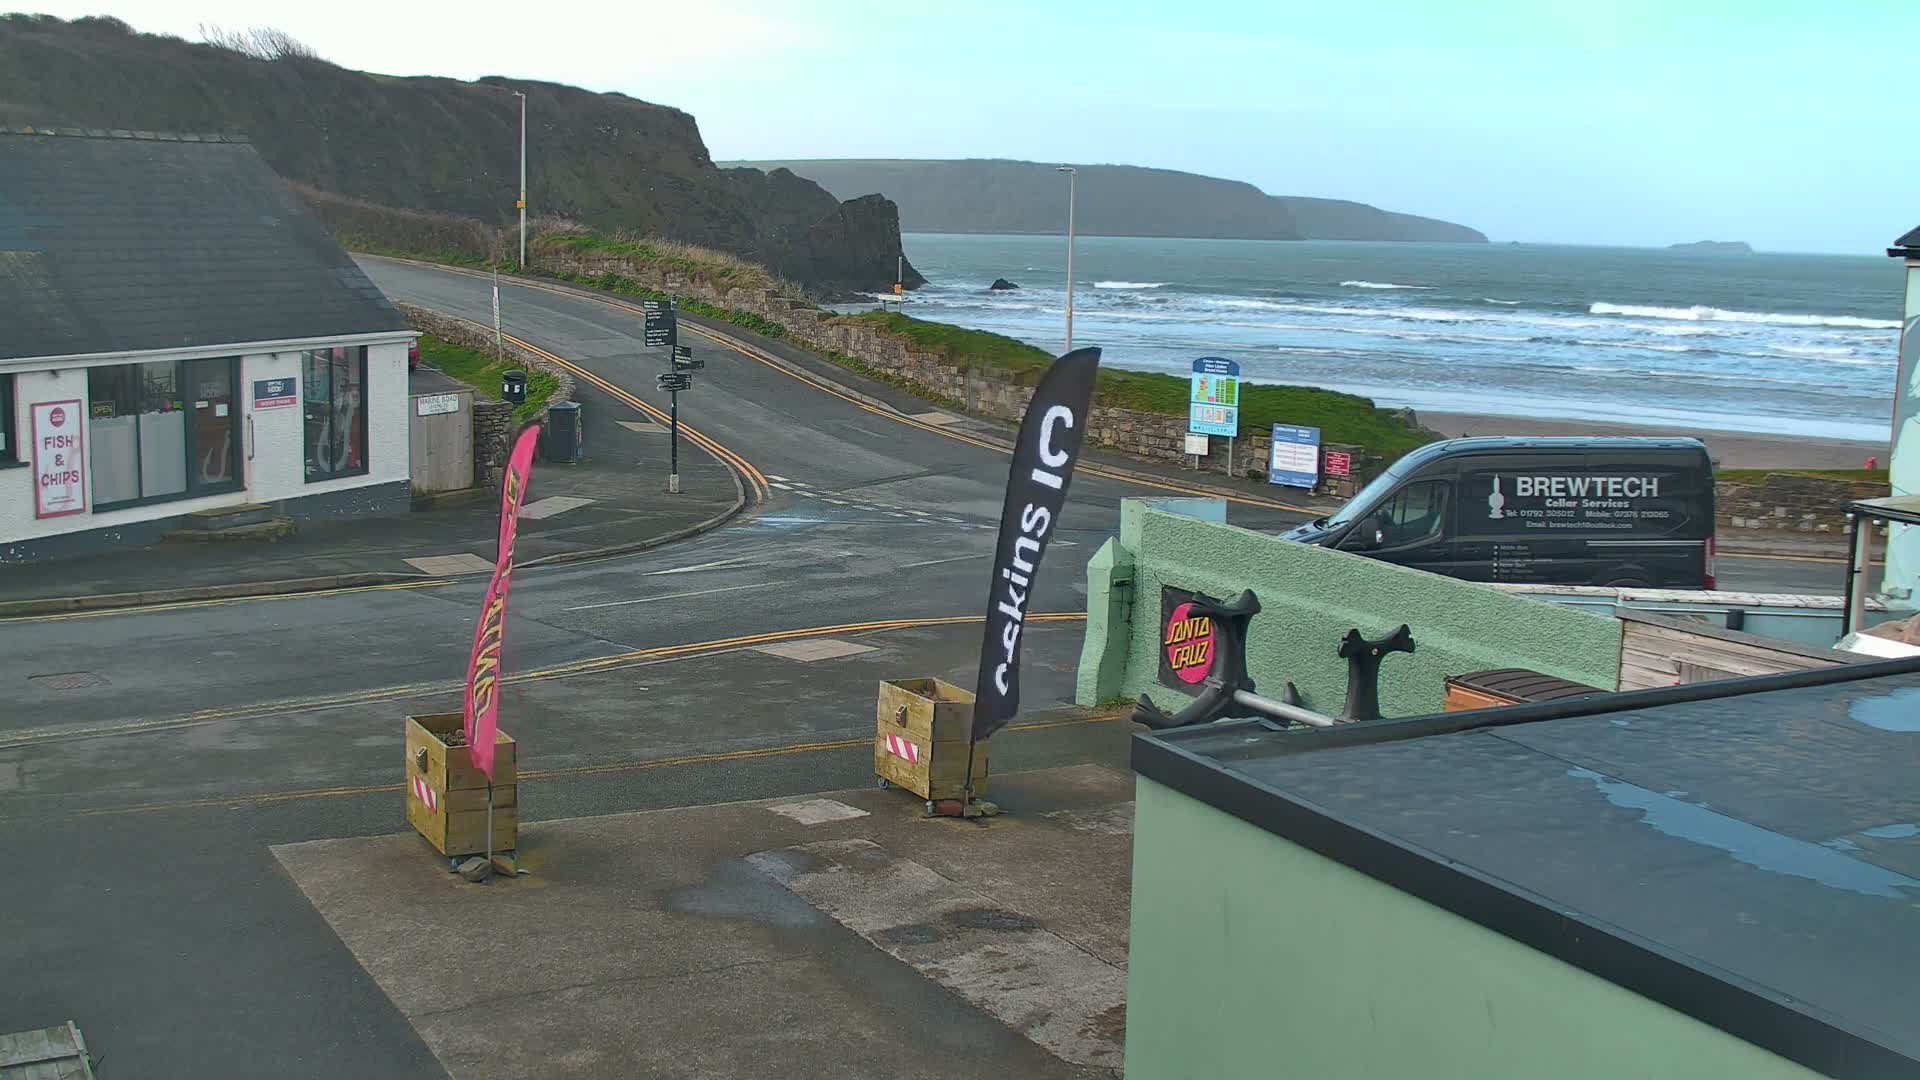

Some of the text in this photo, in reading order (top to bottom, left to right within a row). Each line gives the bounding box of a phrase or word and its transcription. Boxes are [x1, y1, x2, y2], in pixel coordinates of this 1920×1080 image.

[44, 435, 73, 450] FISH
[54, 454, 65, 466] &
[41, 470, 80, 487] CHIPS
[1516, 476, 1659, 497] BREWTECH
[1545, 498, 1630, 508] Cellar Services
[1164, 616, 1210, 645] SANTA
[1172, 640, 1209, 670] CRUZ
